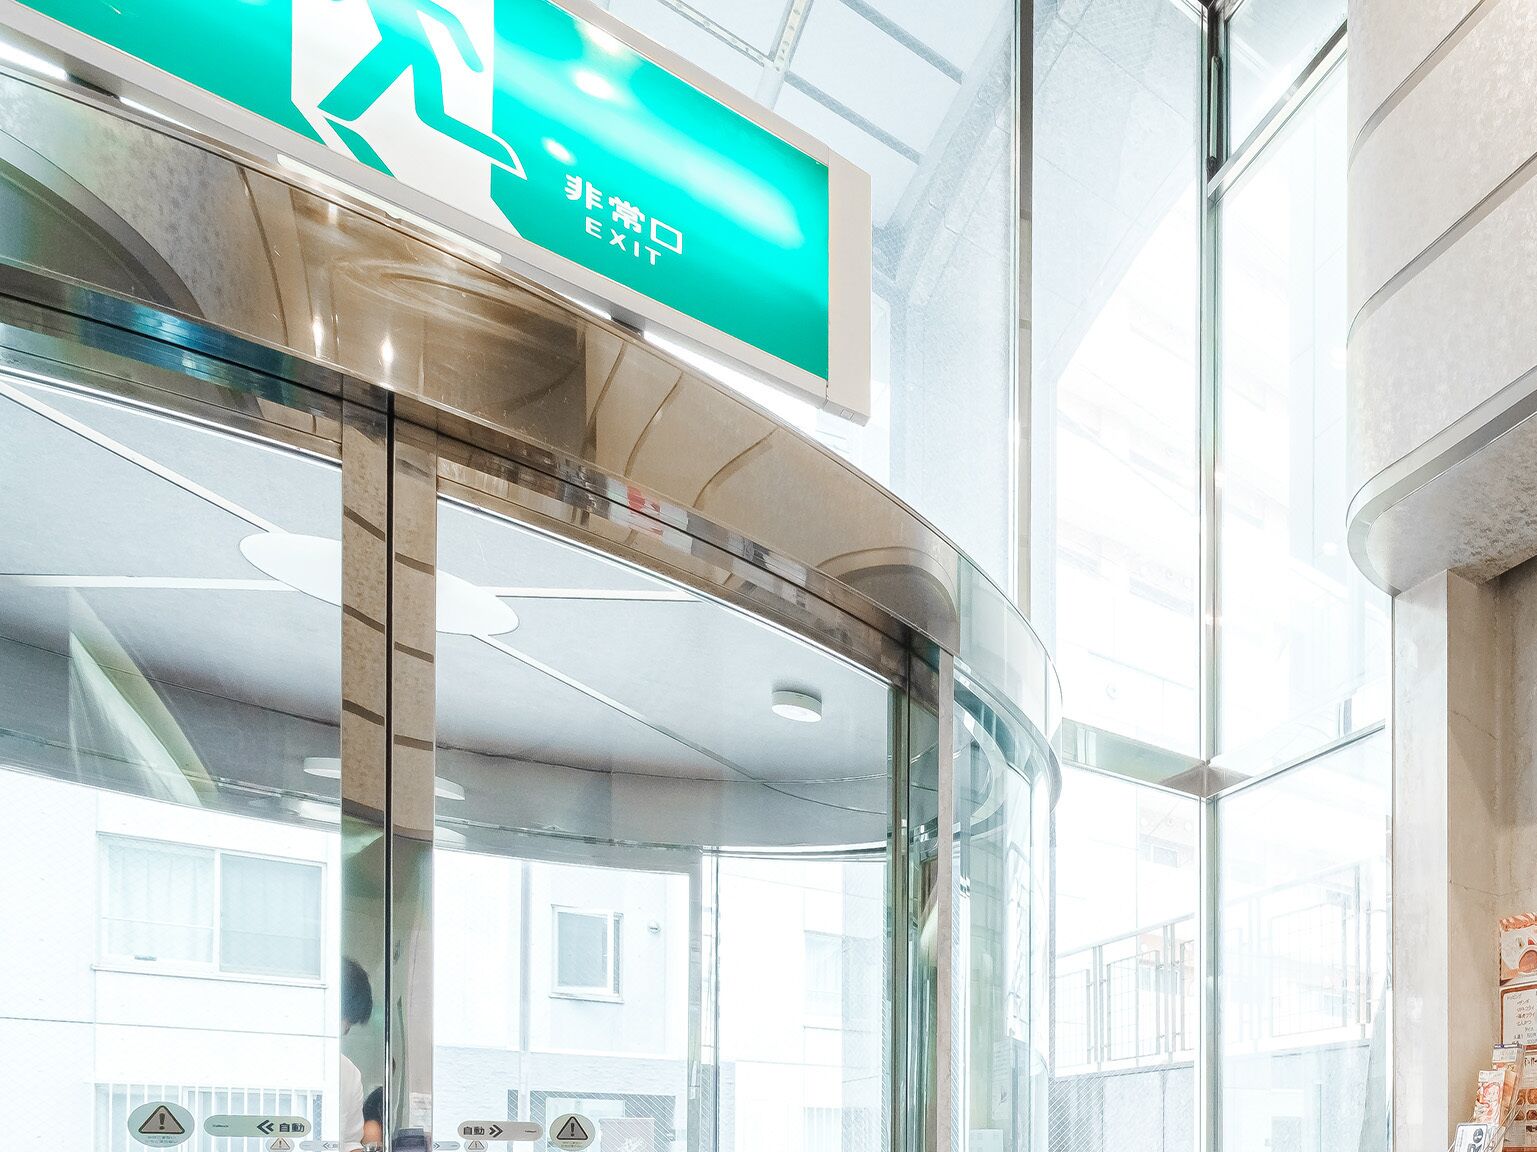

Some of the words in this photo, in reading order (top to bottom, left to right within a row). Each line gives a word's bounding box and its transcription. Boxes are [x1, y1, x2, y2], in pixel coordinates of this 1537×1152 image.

[564, 173, 683, 255] 非常口
[585, 216, 661, 265] EXIT
[279, 1122, 305, 1133] 自動
[463, 1125, 485, 1136] 自動
